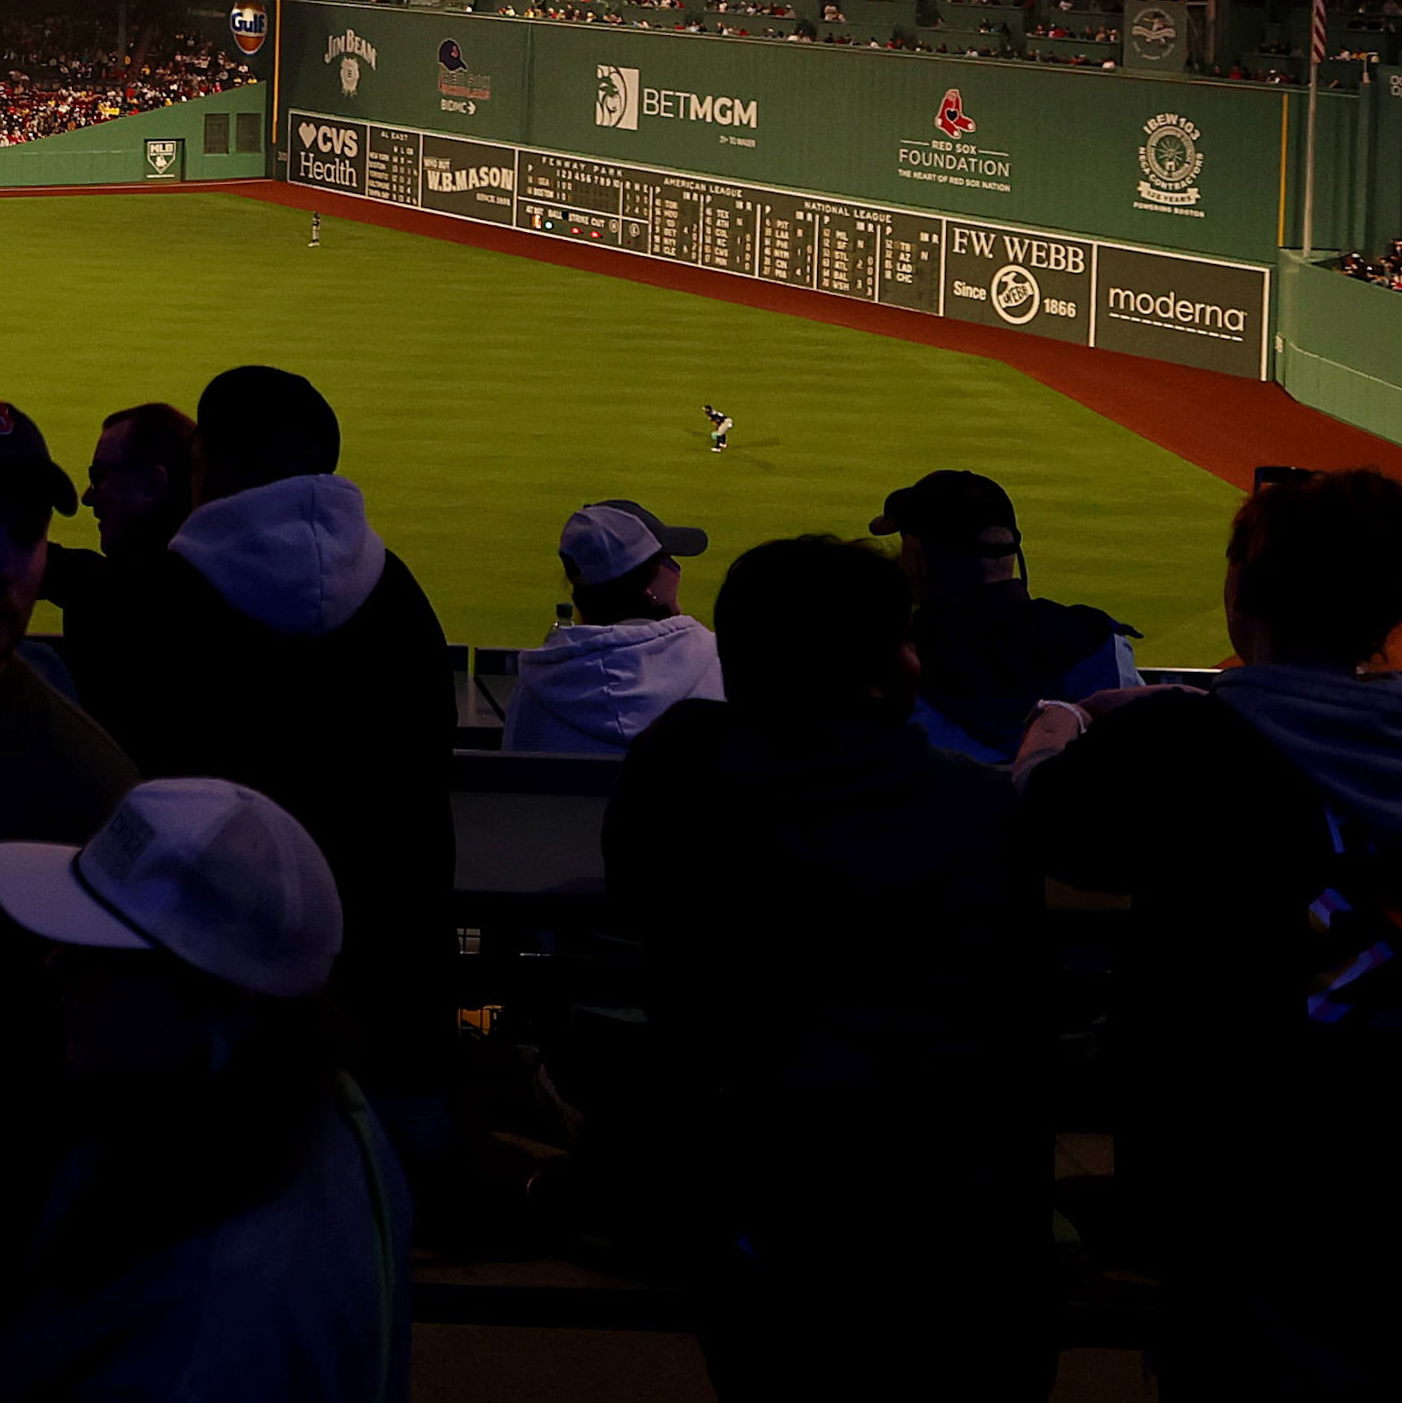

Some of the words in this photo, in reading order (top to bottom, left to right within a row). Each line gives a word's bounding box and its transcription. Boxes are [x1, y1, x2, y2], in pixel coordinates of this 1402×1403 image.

[231, 10, 266, 34] Gulf
[324, 35, 346, 64] JIM
[346, 28, 379, 71] BEAM
[643, 87, 758, 129] BETMGM
[317, 124, 359, 159] CVS
[1143, 113, 1179, 135] IBEW
[1178, 117, 1201, 141] 103
[149, 143, 174, 154] MLB
[931, 139, 953, 153] RED
[955, 143, 978, 156] SOX
[298, 150, 359, 188] Health
[898, 148, 1011, 178] FOUNDATION
[663, 177, 707, 192] AMERICAN
[709, 185, 744, 199] LEAGUE
[898, 168, 913, 179] THE
[913, 170, 936, 183] HEART
[936, 173, 948, 184] OF
[948, 176, 965, 187] RED
[965, 178, 982, 189] SOX
[981, 181, 1012, 193] NATION
[804, 200, 851, 218] NATIONAL
[853, 209, 893, 224] LEAGUE
[952, 227, 996, 260] F.W.
[1003, 235, 1086, 274] WEBB
[953, 280, 987, 301] Since
[1043, 297, 1077, 319] 1866
[1002, 285, 1028, 305] WEBB
[1108, 287, 1245, 332] moderna
